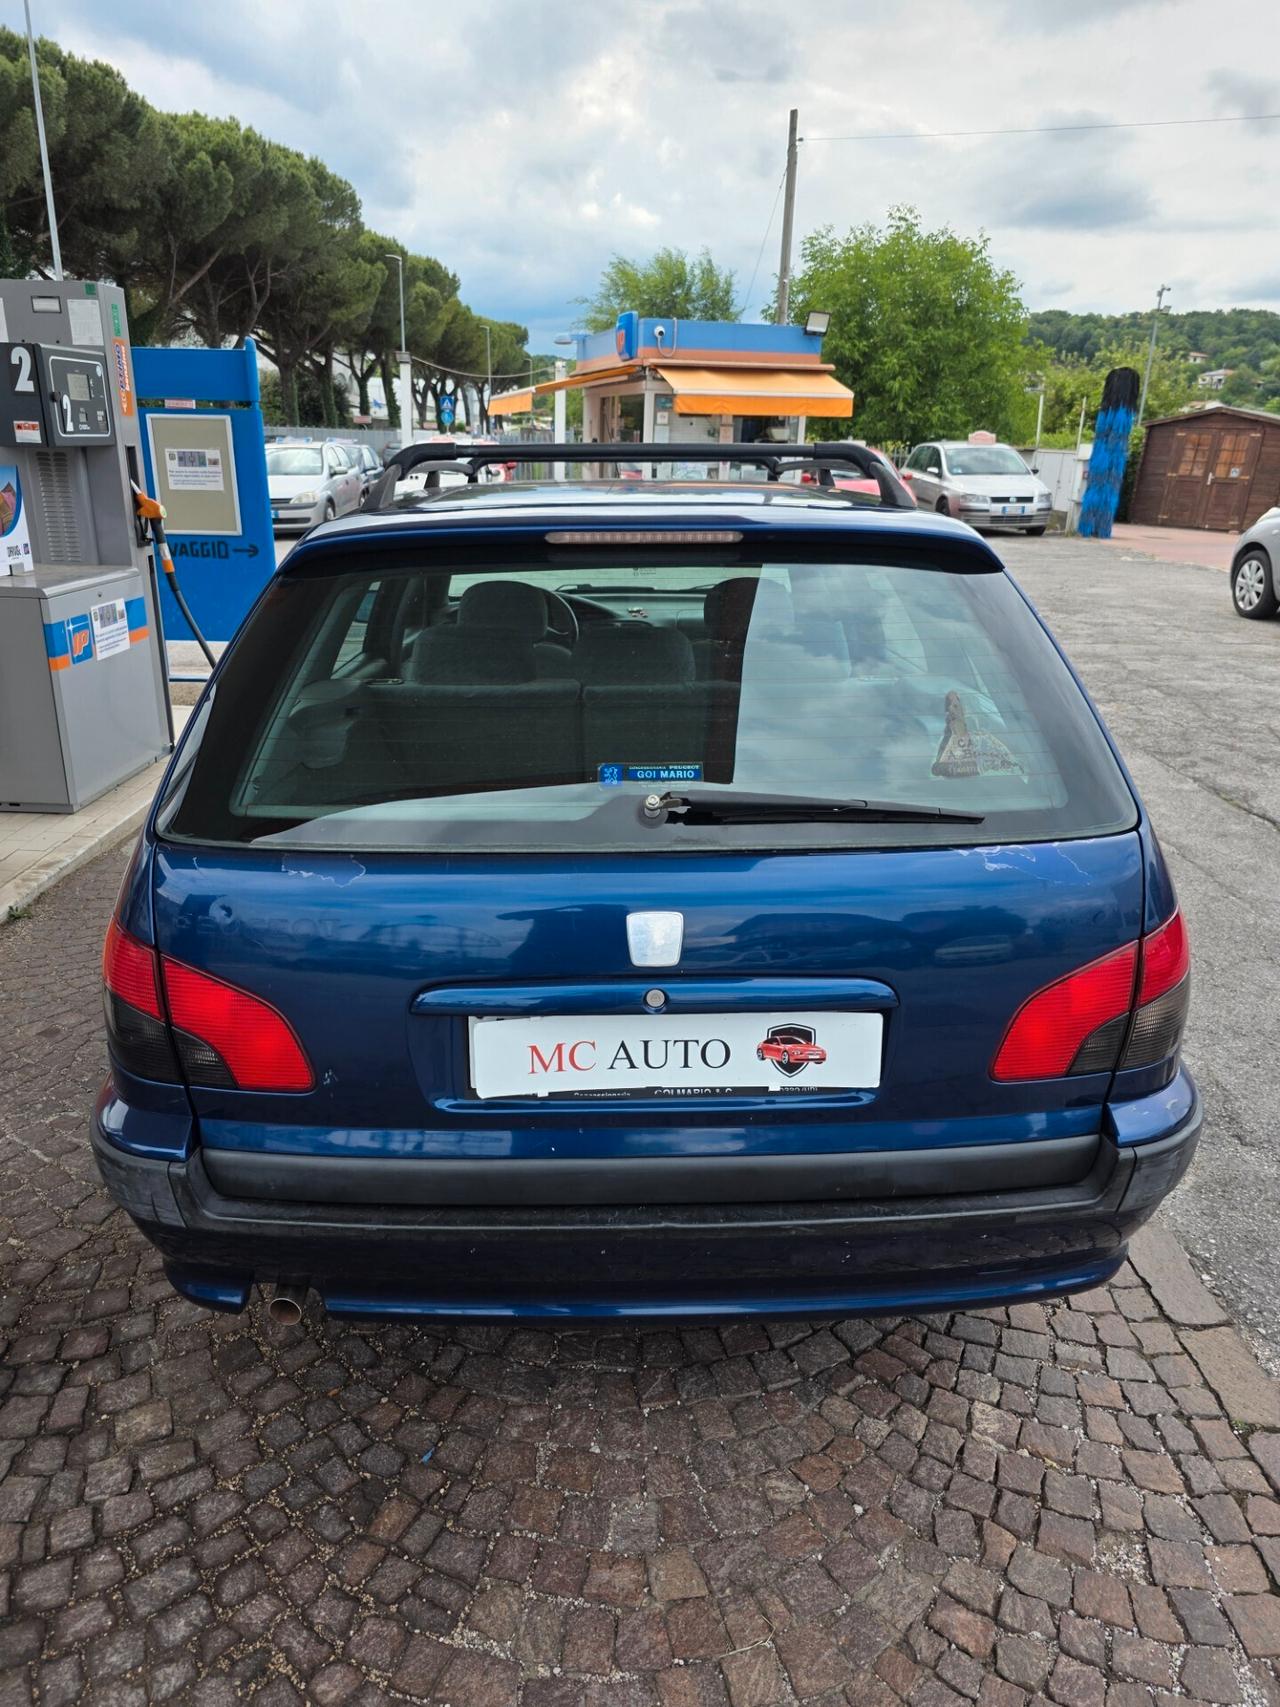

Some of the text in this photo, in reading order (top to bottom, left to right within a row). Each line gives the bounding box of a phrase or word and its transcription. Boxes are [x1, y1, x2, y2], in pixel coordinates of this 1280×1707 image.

[11, 346, 35, 392] 2
[62, 394, 74, 432] 2
[167, 540, 229, 559] VAGGIO
[73, 629, 89, 657] IP
[660, 770, 695, 778] MARIO
[527, 1038, 731, 1075] MC AUTO
